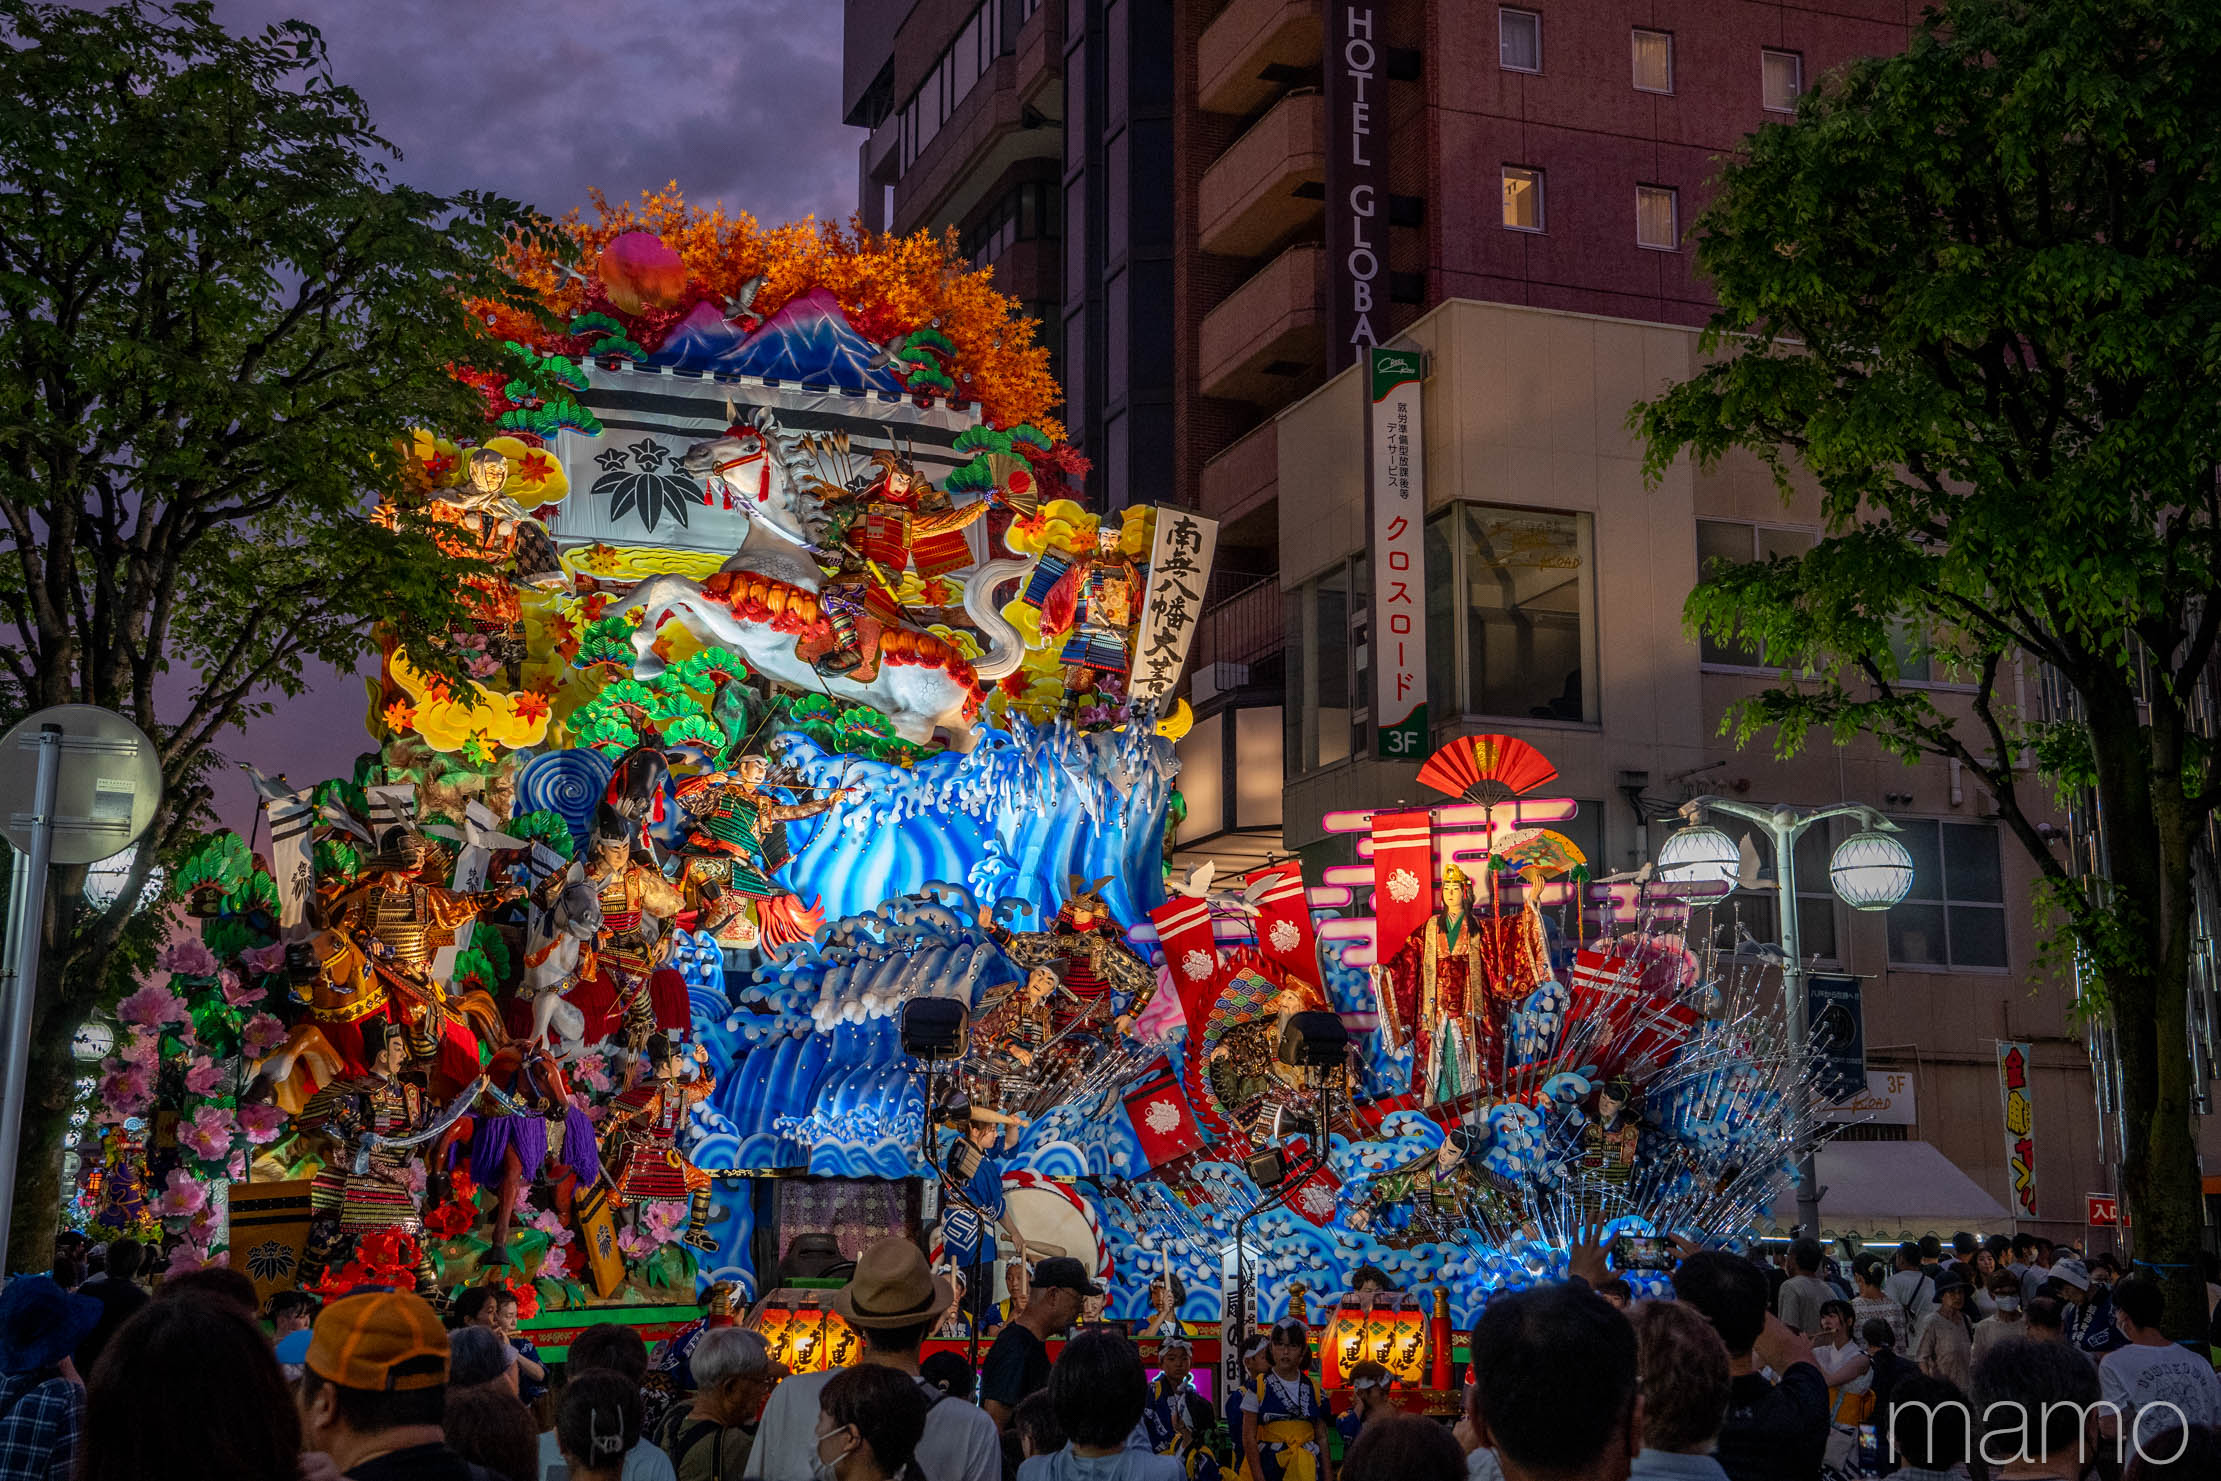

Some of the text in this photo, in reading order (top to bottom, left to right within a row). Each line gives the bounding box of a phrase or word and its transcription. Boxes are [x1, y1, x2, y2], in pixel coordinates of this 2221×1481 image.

[1345, 6, 1376, 166] HOTEL
[1386, 422, 1398, 487] デイサービス
[1387, 515, 1414, 702] クロスロード
[1388, 730, 1418, 753] 3F
[1887, 1075, 1906, 1093] 3F
